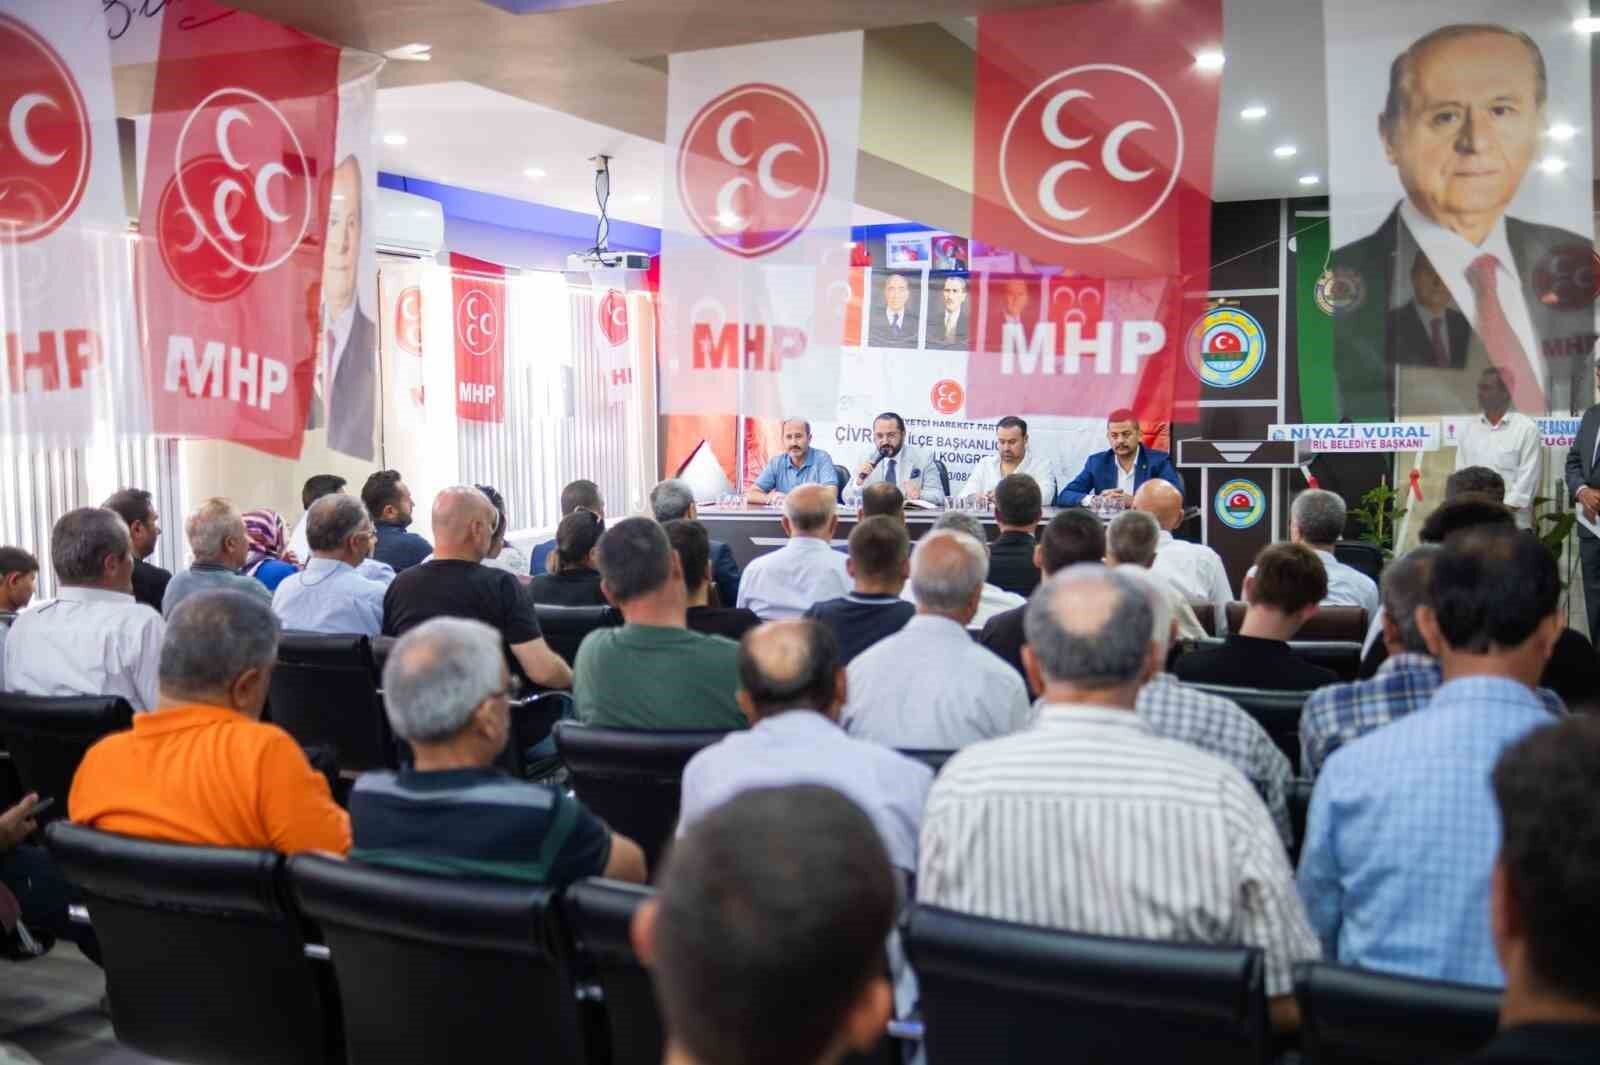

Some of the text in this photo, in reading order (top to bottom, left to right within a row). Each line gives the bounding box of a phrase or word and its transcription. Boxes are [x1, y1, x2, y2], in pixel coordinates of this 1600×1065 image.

[692, 322, 806, 372] MHP
[1001, 319, 1166, 376] MHP
[5, 328, 105, 395] HP
[164, 334, 288, 410] MHP
[459, 382, 496, 404] MHP
[835, 424, 873, 445] ÇİVR
[908, 432, 934, 447] İLÇE
[977, 423, 999, 432] PART
[1290, 424, 1431, 440] NİYAZİ VURAL
[1309, 438, 1423, 450] RİL BELEDİYE BAŞKANI
[940, 450, 995, 464] KONGR
